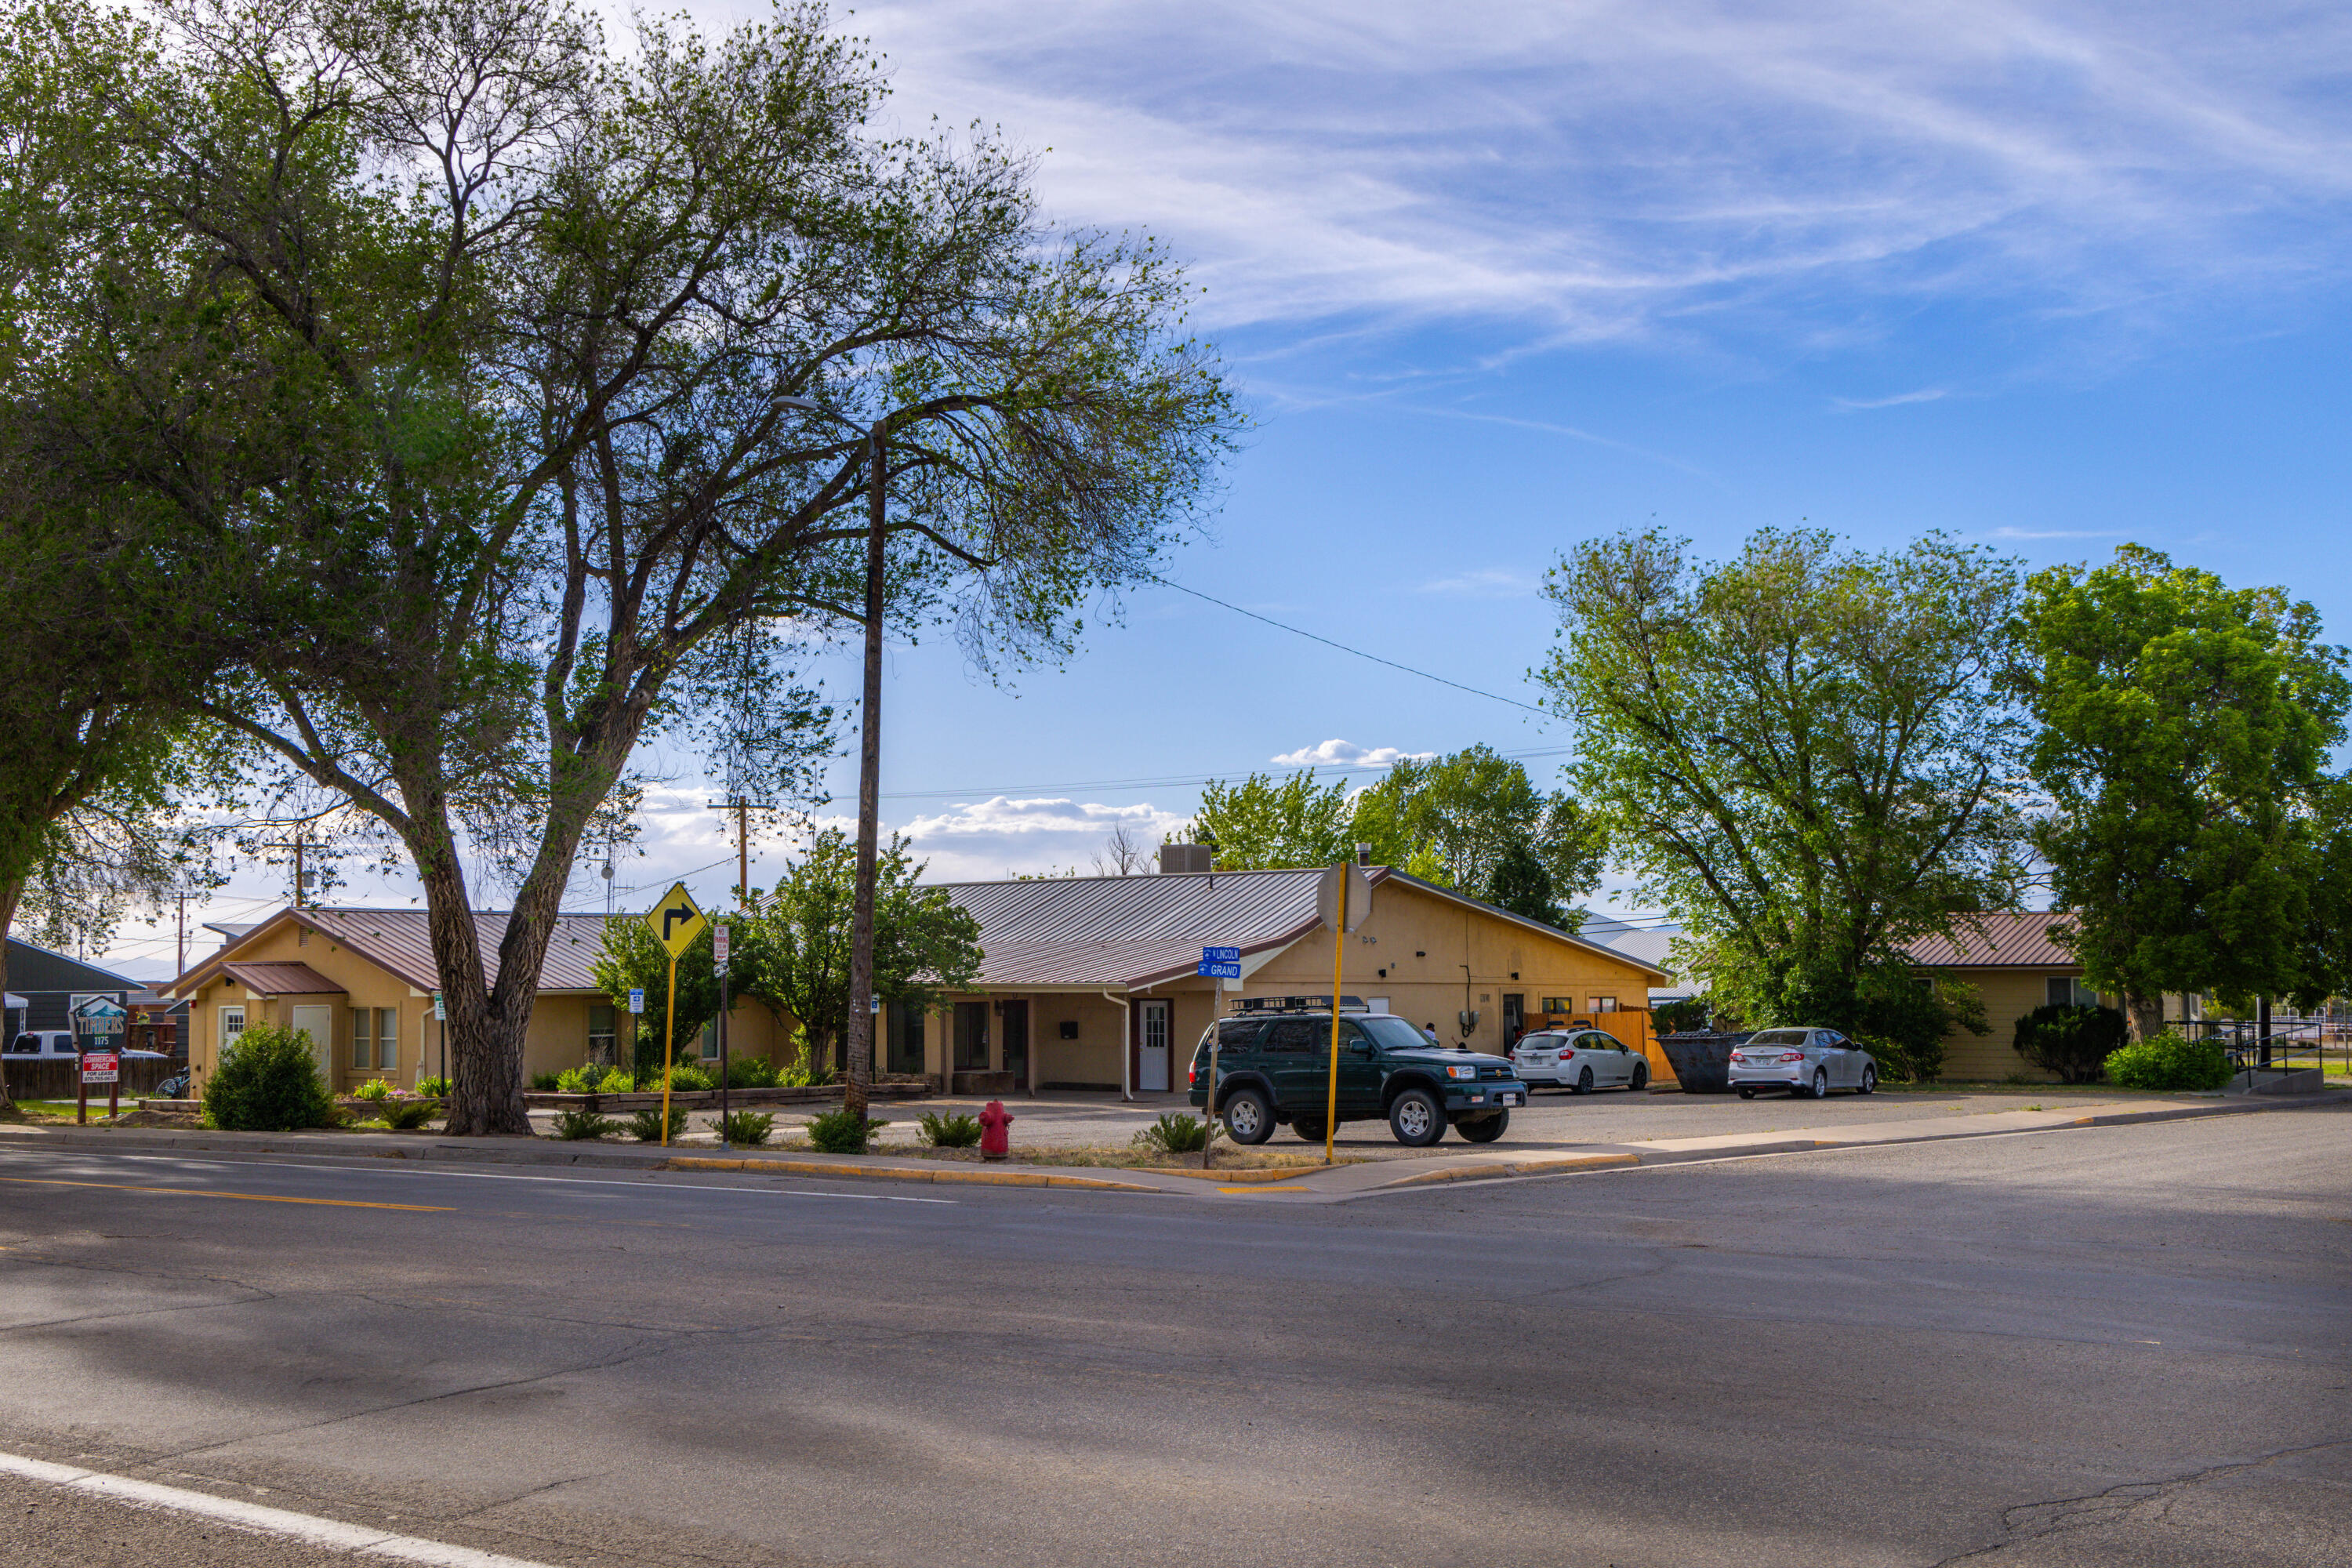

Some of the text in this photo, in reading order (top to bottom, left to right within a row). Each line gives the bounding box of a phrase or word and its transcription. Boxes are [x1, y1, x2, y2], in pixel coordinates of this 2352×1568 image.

[1212, 949, 1215, 957] N
[1216, 949, 1239, 960] LINCOLN
[1210, 964, 1238, 976] GRAND
[78, 1015, 124, 1035] TIMBERS
[94, 1036, 109, 1045] 1175
